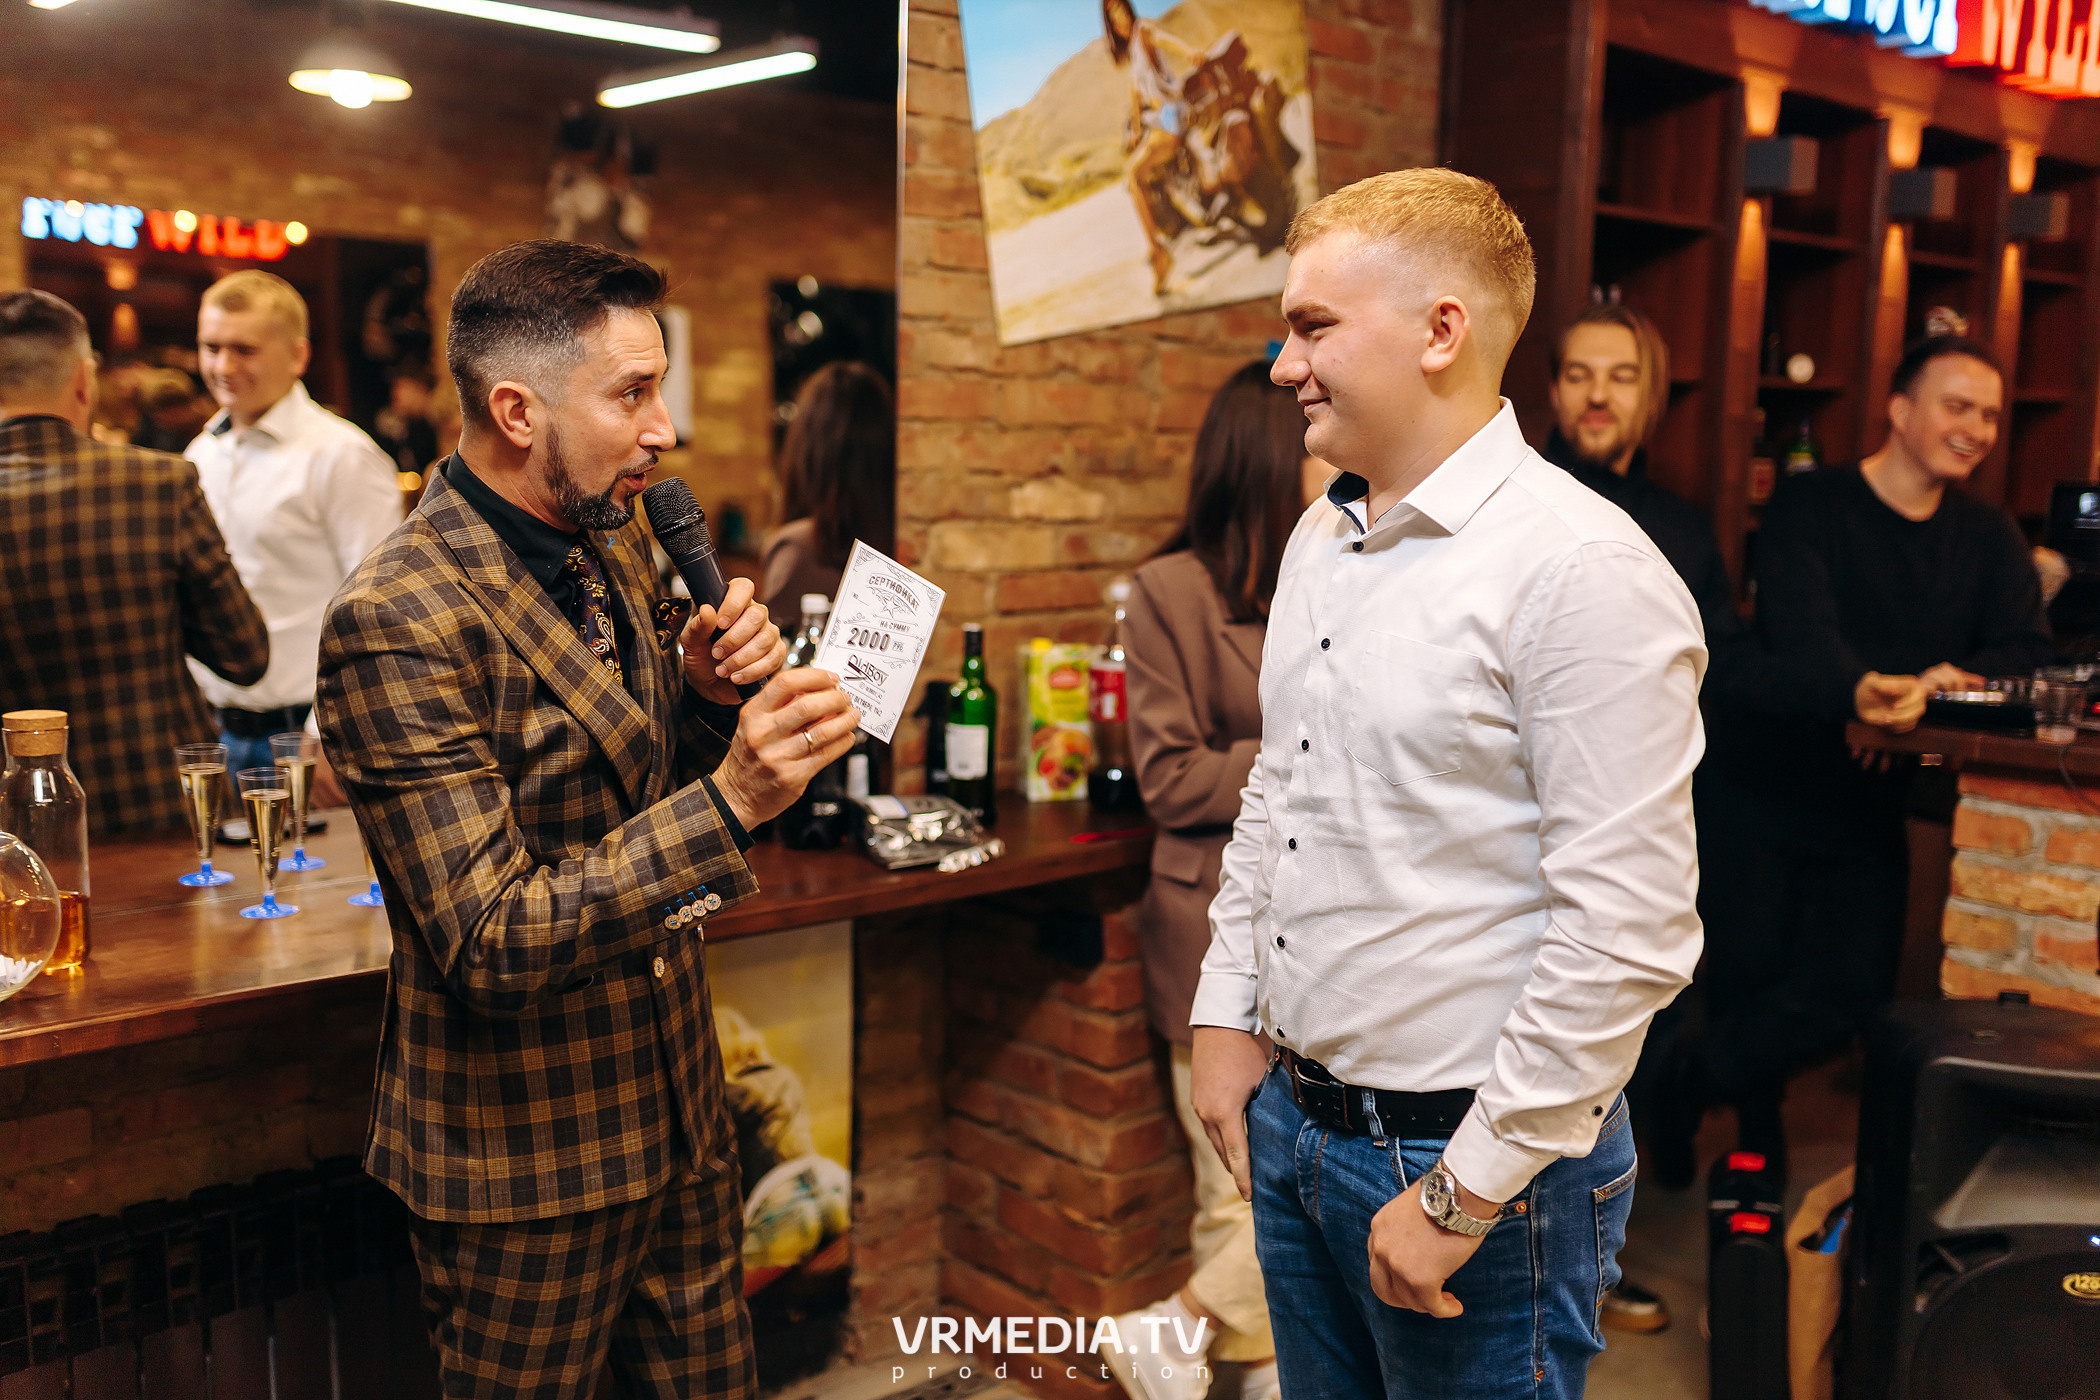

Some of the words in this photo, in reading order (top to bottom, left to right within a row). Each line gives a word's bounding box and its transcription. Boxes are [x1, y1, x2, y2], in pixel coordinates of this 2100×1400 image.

[868, 575, 920, 611] СЕРТИФИКАТ
[847, 627, 891, 652] 2000
[888, 622, 911, 633] СУММУ
